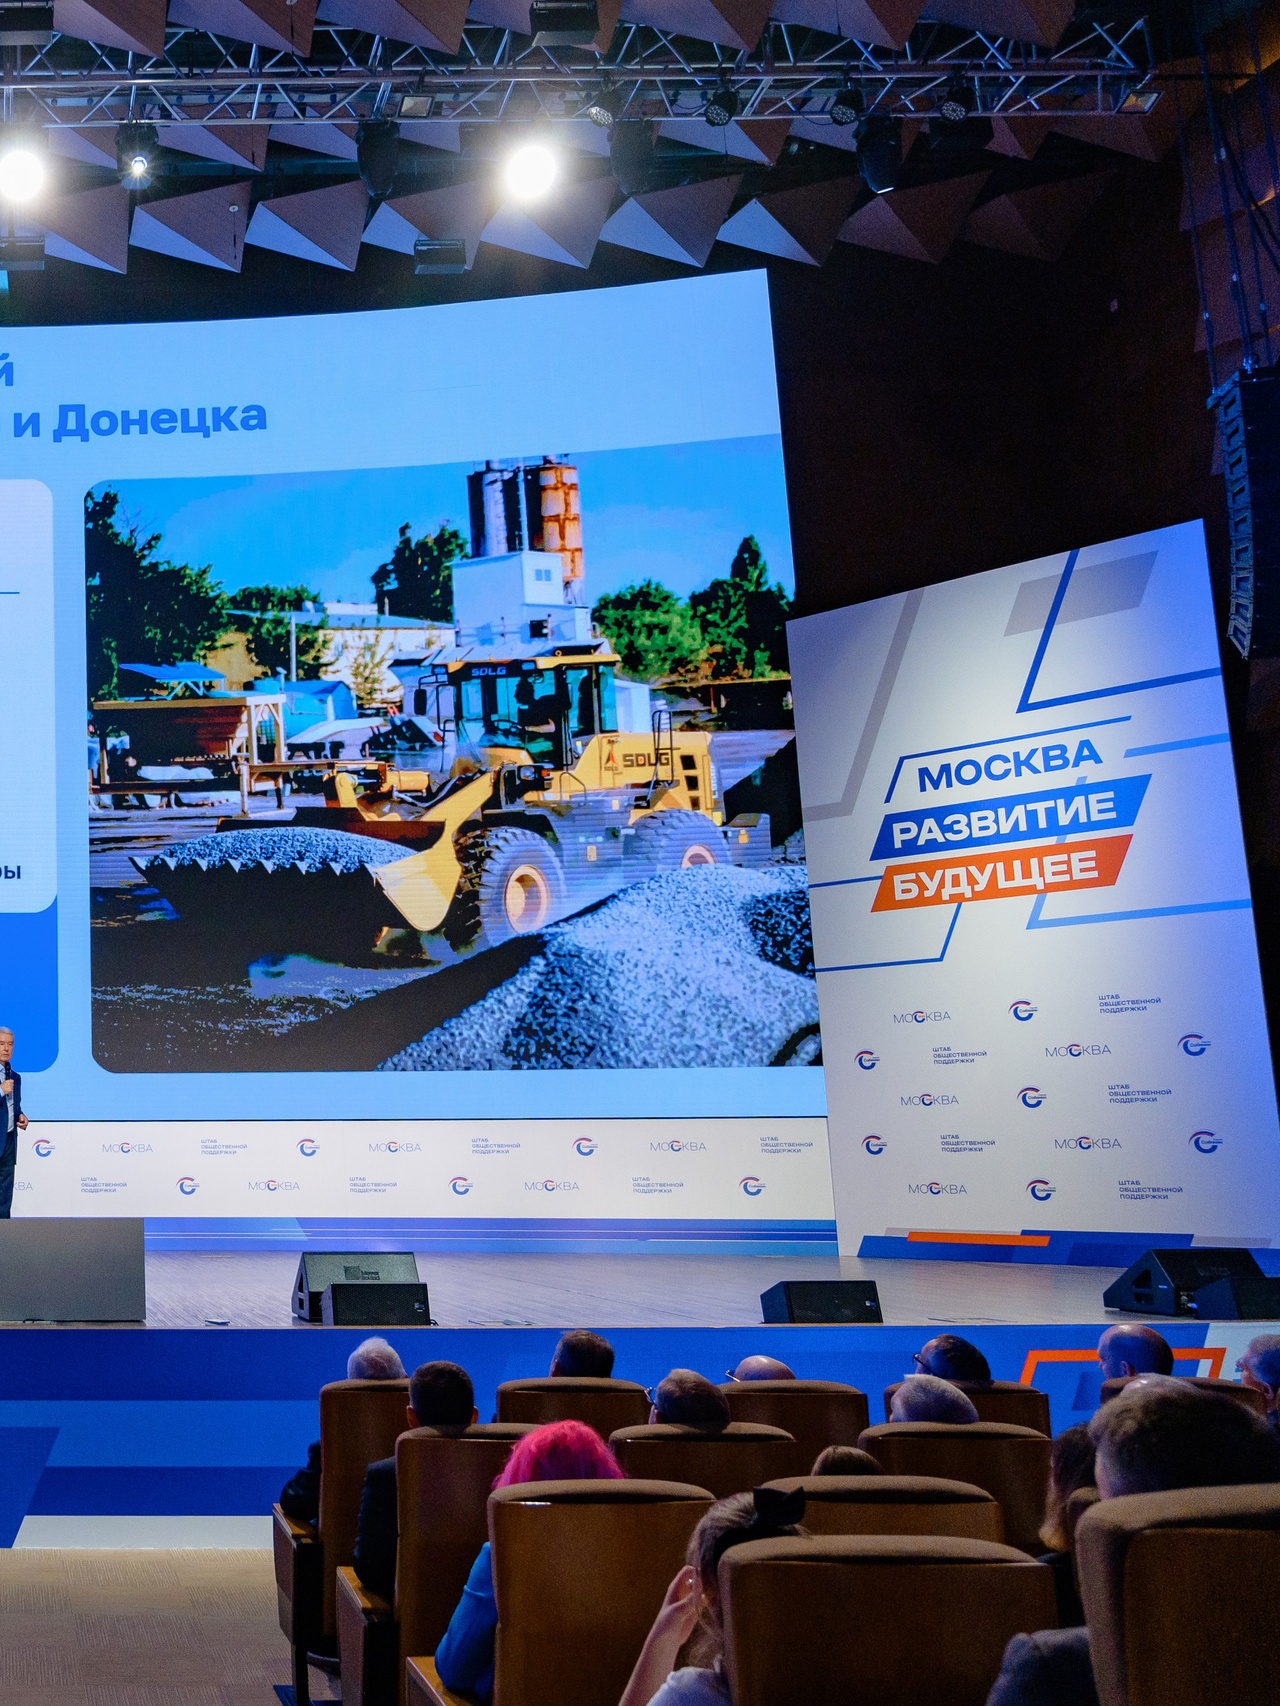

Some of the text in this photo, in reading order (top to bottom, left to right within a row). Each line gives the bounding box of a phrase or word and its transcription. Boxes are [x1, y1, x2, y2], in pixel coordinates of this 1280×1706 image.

[13, 412, 40, 438] и
[52, 404, 267, 443] Донецка
[471, 666, 507, 676] SDLG
[918, 739, 1103, 792] МОСКВА
[892, 791, 1117, 848] РАЗВИТИЕ
[893, 850, 1098, 900] БУДУЩЕЕ
[1098, 996, 1162, 1007] ОБЩЕСТВЕННОЙ
[1099, 1005, 1147, 1014] ПОДДЕРЖКИ
[893, 1010, 951, 1024] МОСКВА
[932, 1050, 987, 1059] ОБЩЕСТВЕННОЙ
[1045, 1044, 1112, 1057] МОСКВА
[1108, 1088, 1172, 1097] ОБЩЕСТВЕННОЙ
[900, 1094, 959, 1106] МОСКВА
[102, 1142, 152, 1154] МОСКВА
[369, 1141, 422, 1153] МОСКВА
[650, 1140, 707, 1152] МОСКВА
[1054, 1136, 1122, 1150] МОСКВА
[248, 1180, 300, 1192] МОСКВА
[524, 1180, 580, 1192] МОСКВА
[908, 1182, 968, 1195] МОСКВА
